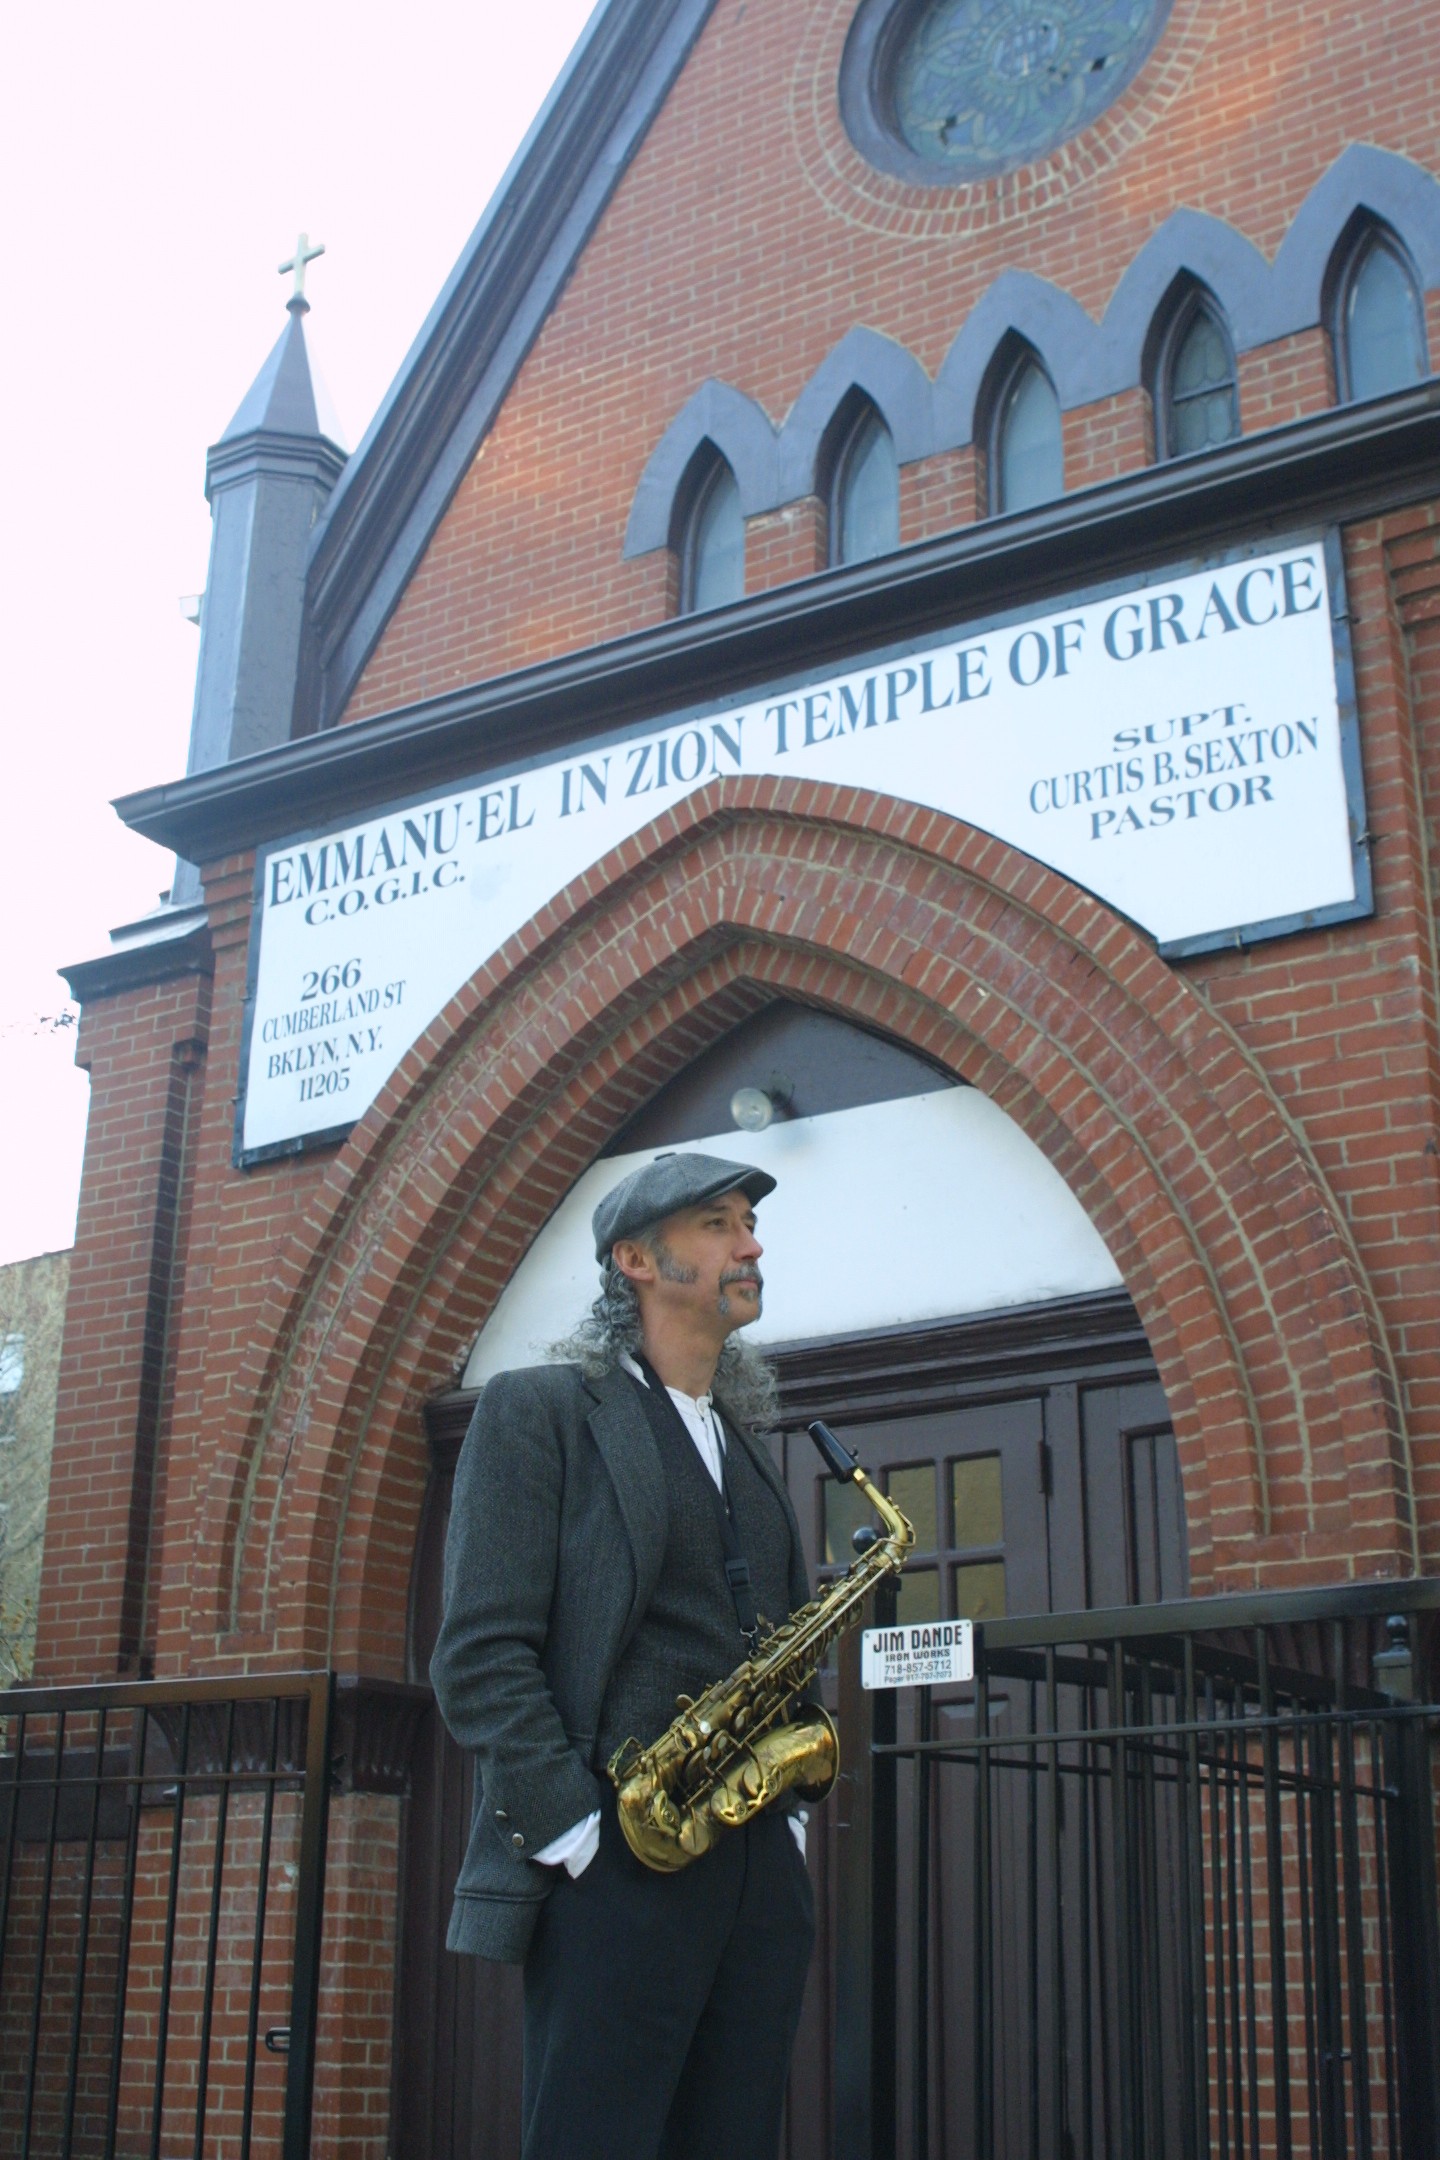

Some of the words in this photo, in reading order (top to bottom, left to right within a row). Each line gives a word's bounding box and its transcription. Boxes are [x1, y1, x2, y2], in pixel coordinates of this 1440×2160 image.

[268, 783, 535, 908] EMMANU-EL
[558, 756, 612, 818] IN
[624, 716, 746, 798] ZION
[764, 645, 992, 755] TEMPLE
[1008, 618, 1086, 687] OF
[1103, 556, 1322, 661] GRACE
[1112, 703, 1252, 752] SUPT.
[1029, 758, 1144, 814] CURTIS
[1184, 717, 1319, 780] SEXTON
[1090, 774, 1275, 840] PASTOR
[304, 860, 466, 926] C.O.G.I.C.
[301, 958, 362, 1001] 266
[262, 987, 380, 1044] CUMBERLAND
[384, 980, 407, 1010] ST
[267, 1037, 340, 1079] BKLYN,
[346, 1026, 383, 1058] N.Y.
[299, 1068, 350, 1102] 11205
[873, 1631, 905, 1653] JIM
[911, 1625, 962, 1650] DANDE
[886, 1652, 909, 1662] IRON
[913, 1649, 950, 1659] WORKS
[885, 1660, 951, 1674] 718-857-5712
